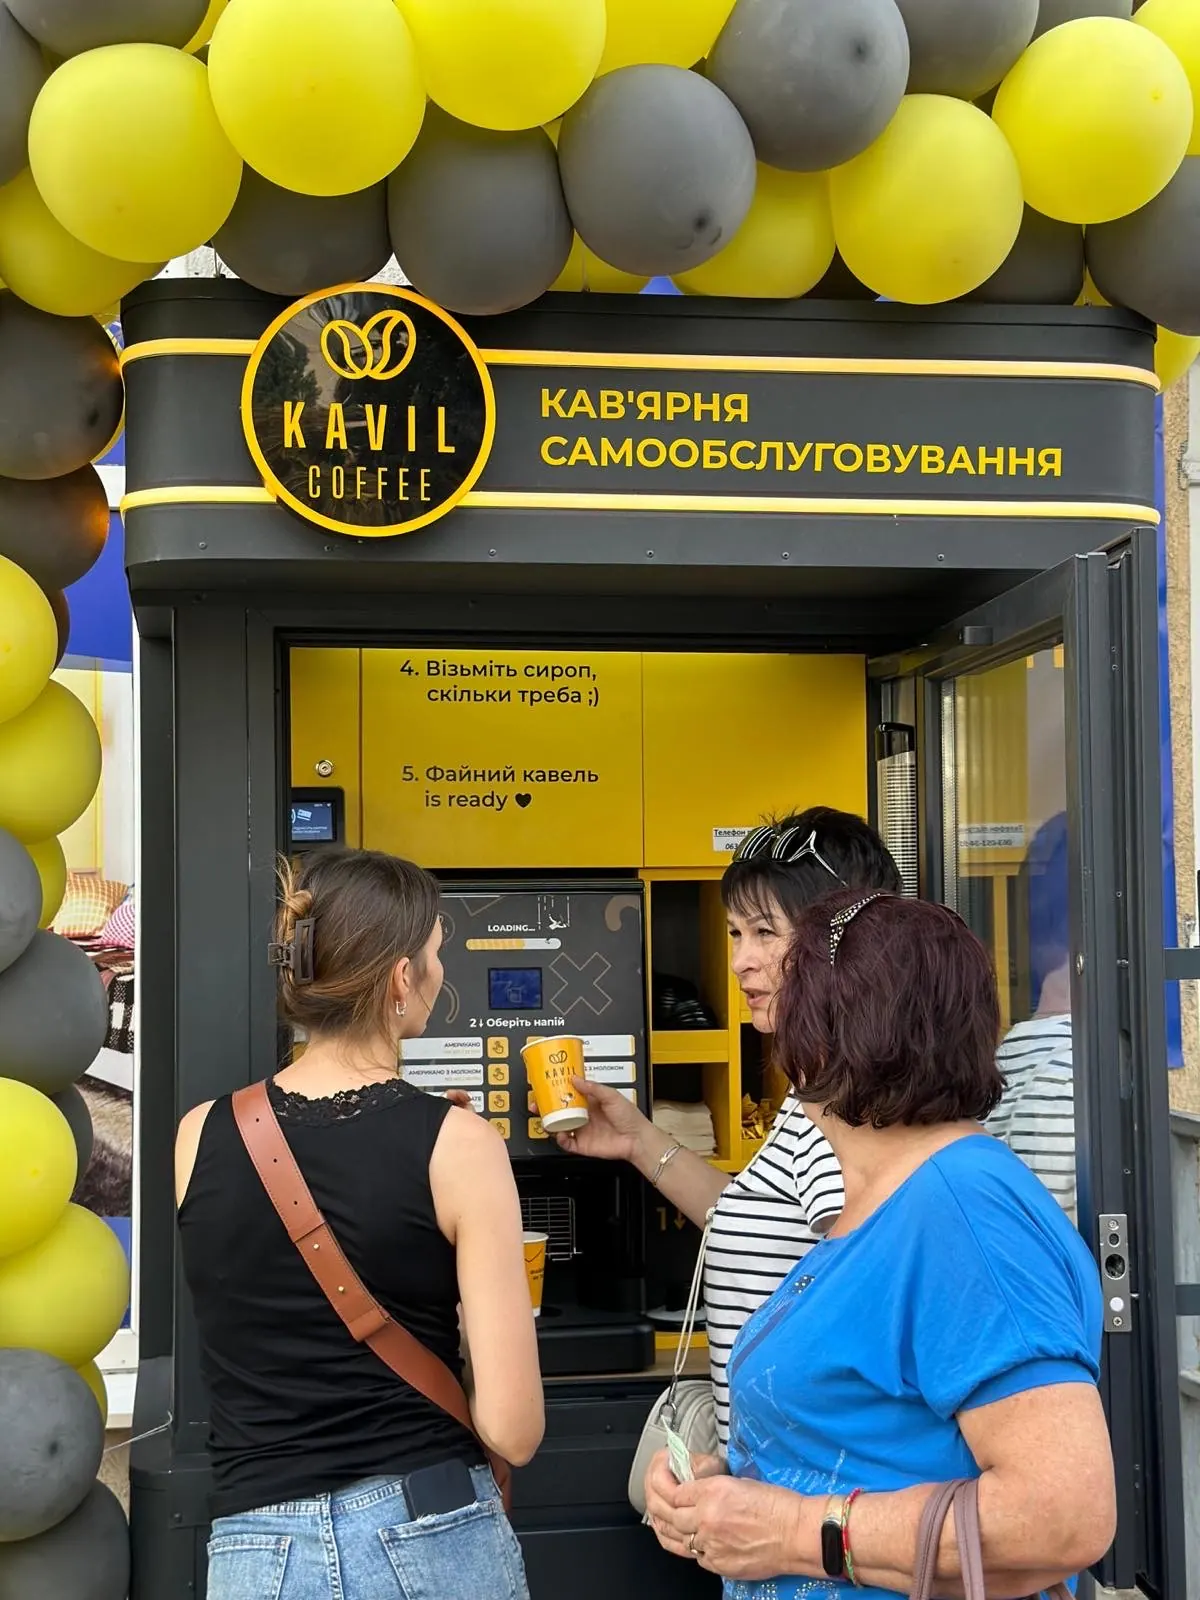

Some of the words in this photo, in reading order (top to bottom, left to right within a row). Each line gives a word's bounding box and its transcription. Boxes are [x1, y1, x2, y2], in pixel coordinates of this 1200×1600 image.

[540, 387, 749, 423] КАВ'ЯРНЯ
[283, 400, 456, 454] KAVIL
[540, 435, 1063, 478] САМООБСЛУГОВУВАННЯ
[307, 464, 432, 501] COFFEE
[399, 659, 420, 677] 4.
[426, 659, 518, 678] Візьміть
[523, 664, 597, 682] сироп,
[426, 686, 512, 703] скільки
[518, 686, 582, 706] треба
[401, 766, 420, 782] 5.
[425, 765, 516, 783] Файний
[523, 769, 599, 783] кавель
[424, 790, 442, 808] is
[448, 790, 508, 811] ready
[469, 1018, 477, 1028] 2
[486, 1017, 531, 1029] Оберіть
[533, 1016, 565, 1027] напій
[544, 1065, 577, 1080] KAVIL
[656, 1207, 666, 1231] 1
